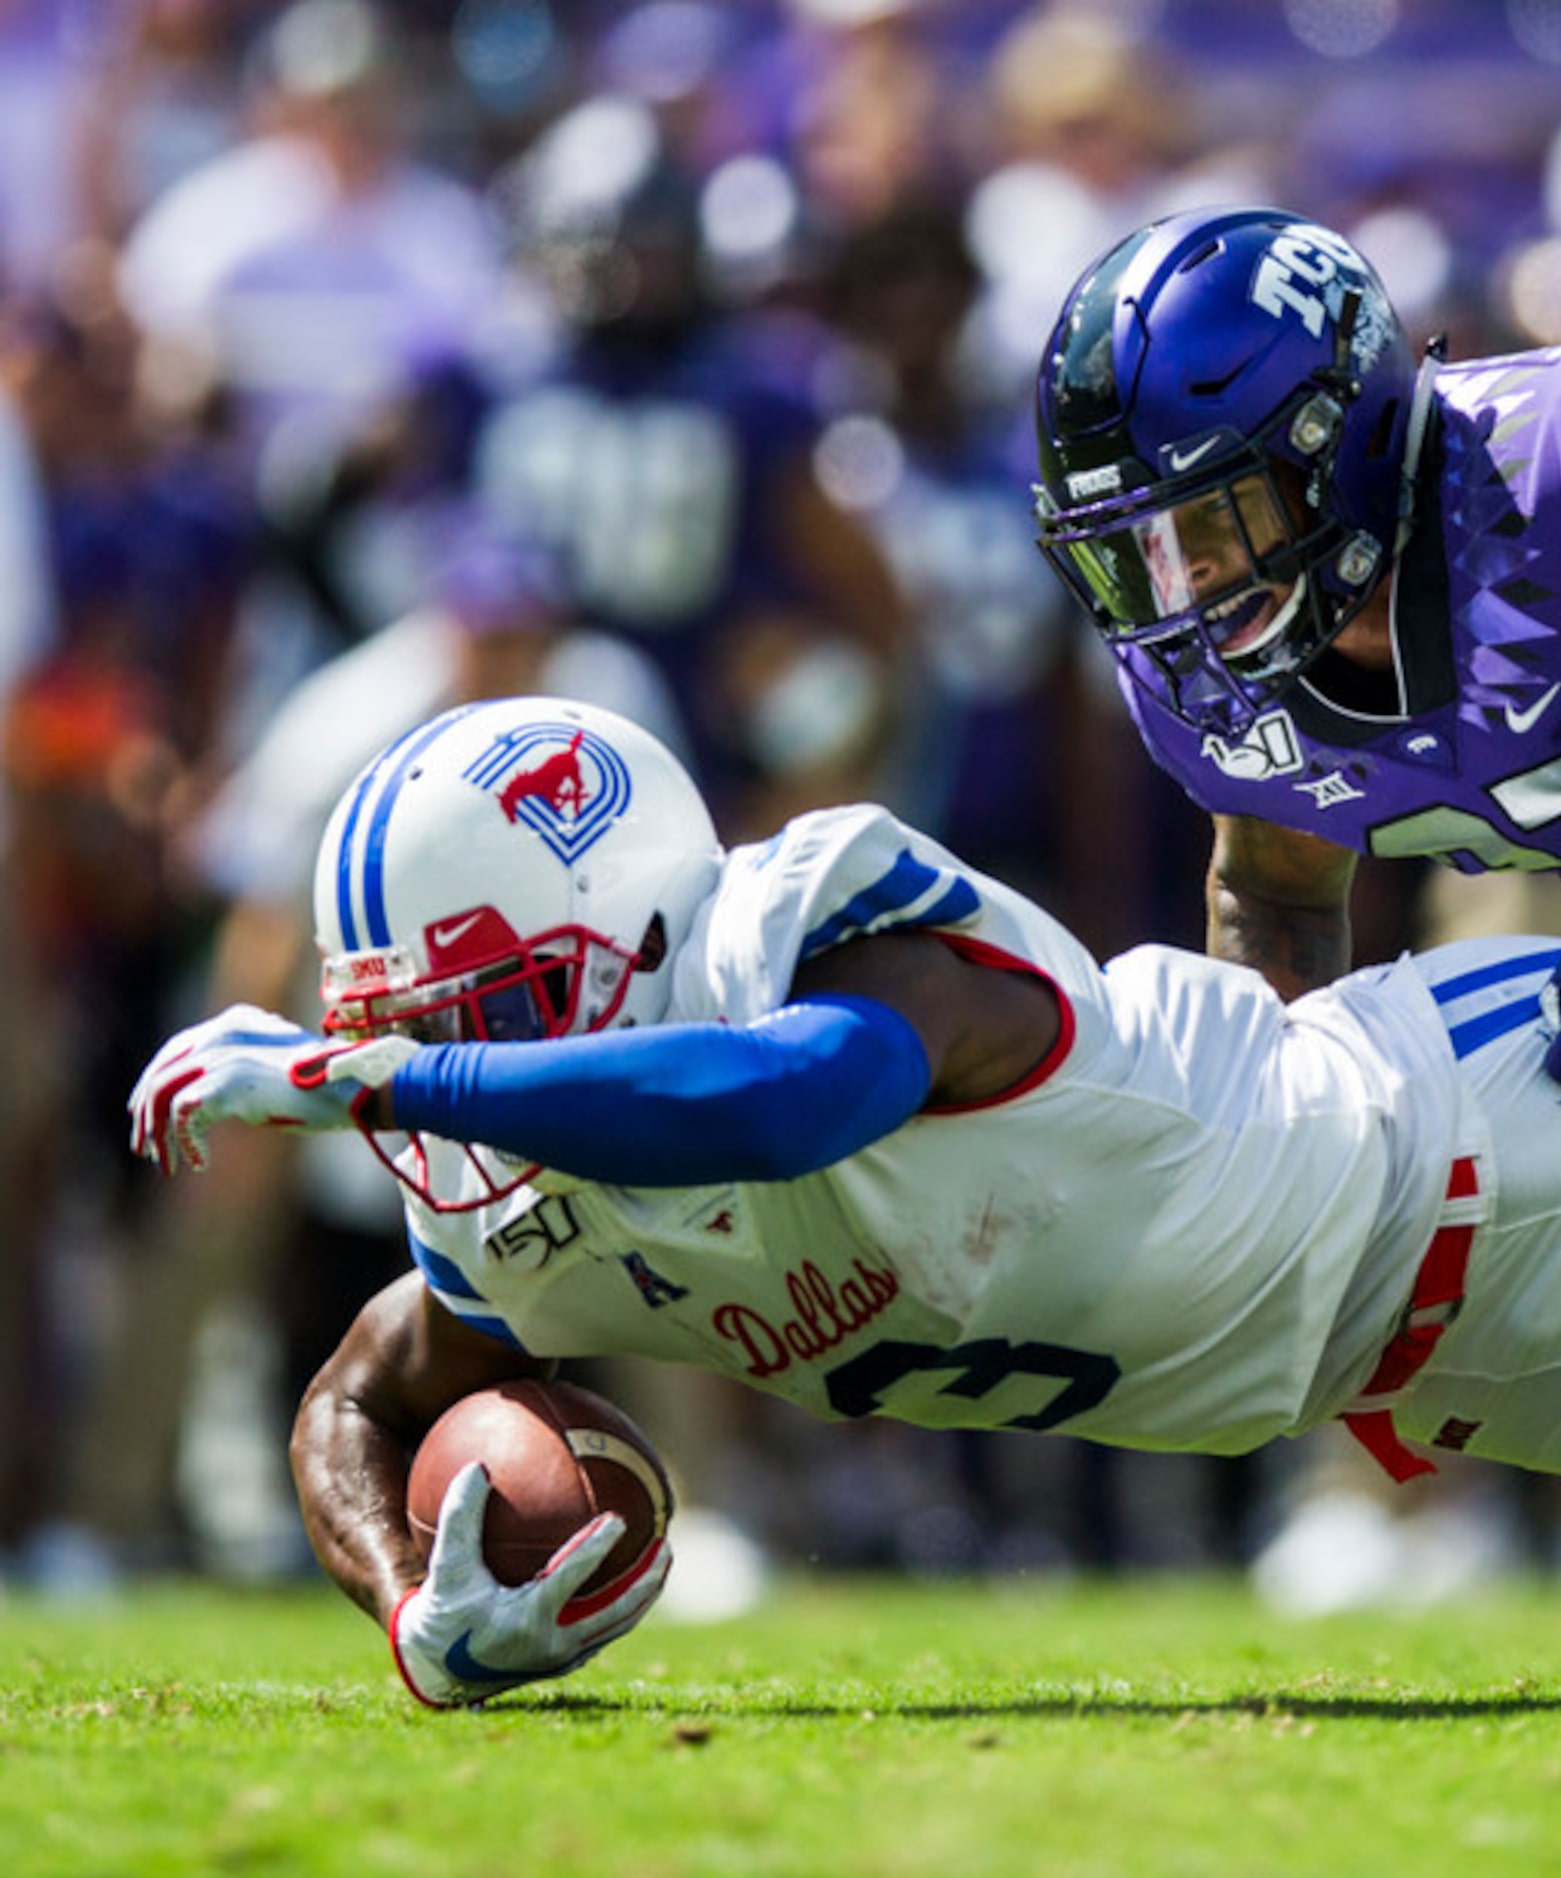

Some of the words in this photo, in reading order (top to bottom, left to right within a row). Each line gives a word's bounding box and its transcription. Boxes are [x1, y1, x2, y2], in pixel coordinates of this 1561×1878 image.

[1252, 224, 1369, 338] TCU
[350, 957, 387, 980] SMU
[485, 1194, 581, 1271] 150
[711, 1257, 900, 1378] Dallas
[825, 1336, 1123, 1431] 3
